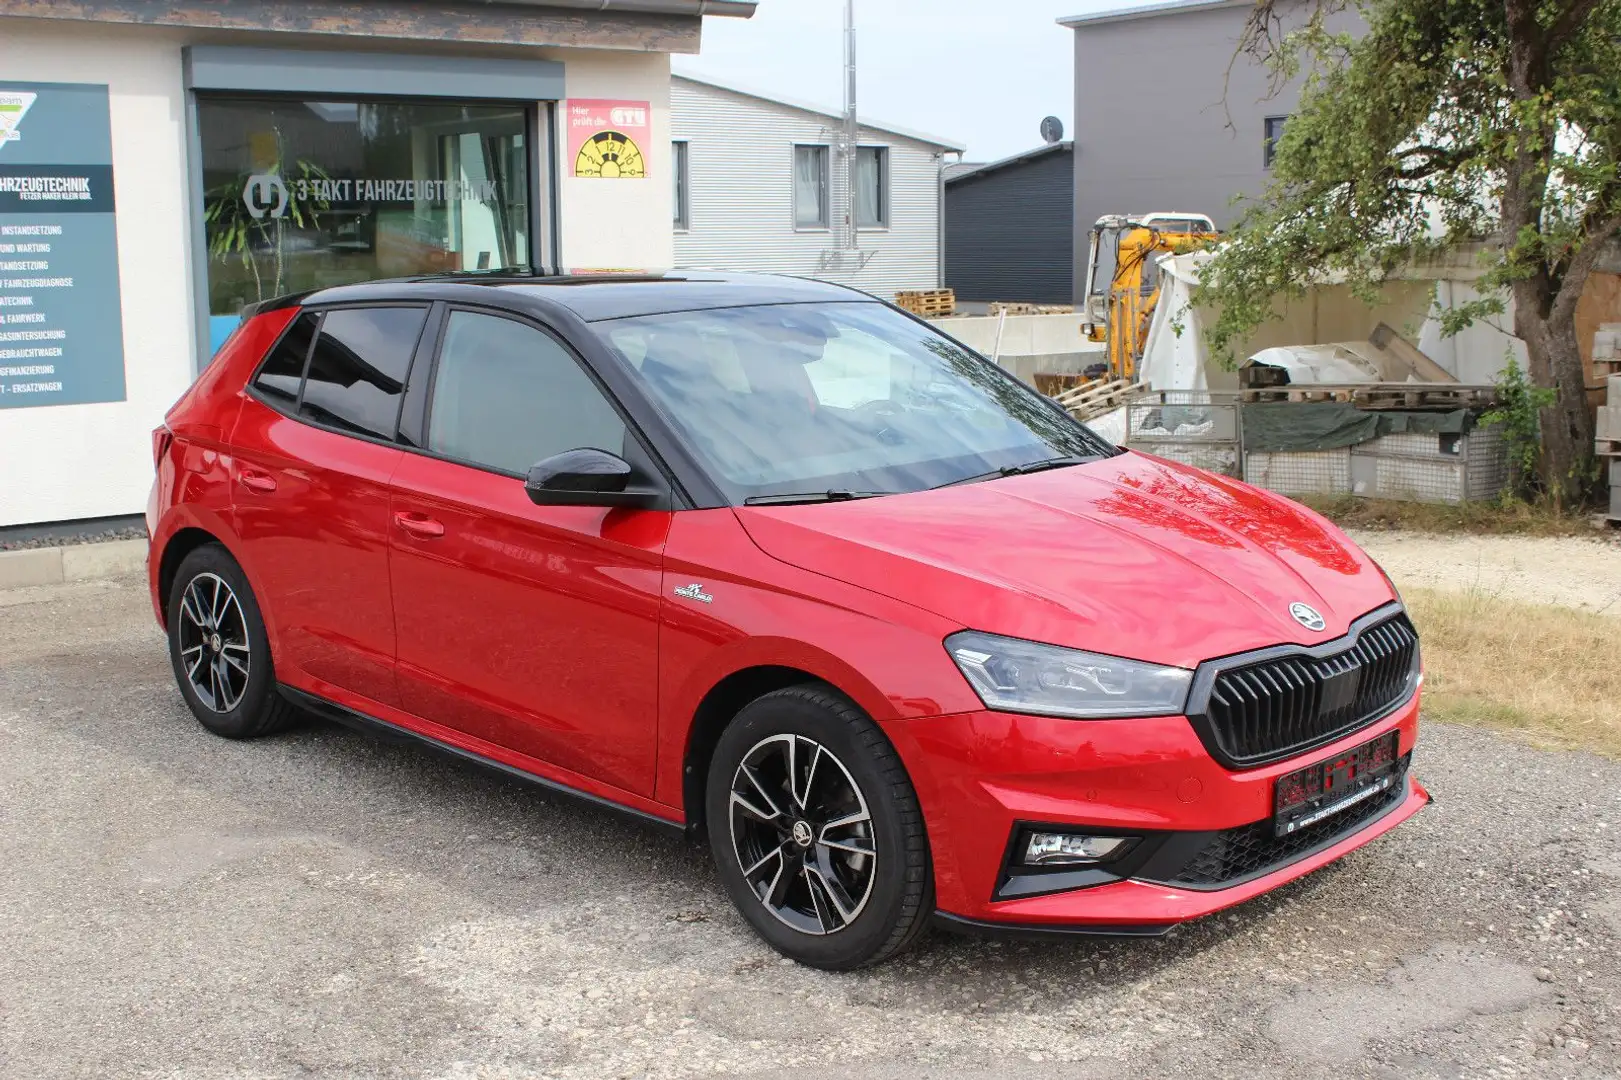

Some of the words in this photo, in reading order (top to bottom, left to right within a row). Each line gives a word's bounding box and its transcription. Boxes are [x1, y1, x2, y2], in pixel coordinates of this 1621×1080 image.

[572, 106, 589, 115] Hier
[606, 141, 615, 151] 12
[587, 155, 596, 164] 2
[624, 153, 634, 165] 10
[297, 180, 308, 201] 3
[313, 180, 350, 201] TAKT
[356, 180, 497, 201] FAHRZEUGTECHNIK
[1, 225, 62, 235] INSTANDSETZUNG
[16, 243, 51, 253] WARTUNG
[4, 277, 74, 288] FAHRZEUGDIAGNOSE
[7, 313, 46, 323] FAHRWERK
[12, 382, 63, 394] ERSATZWAGEN
